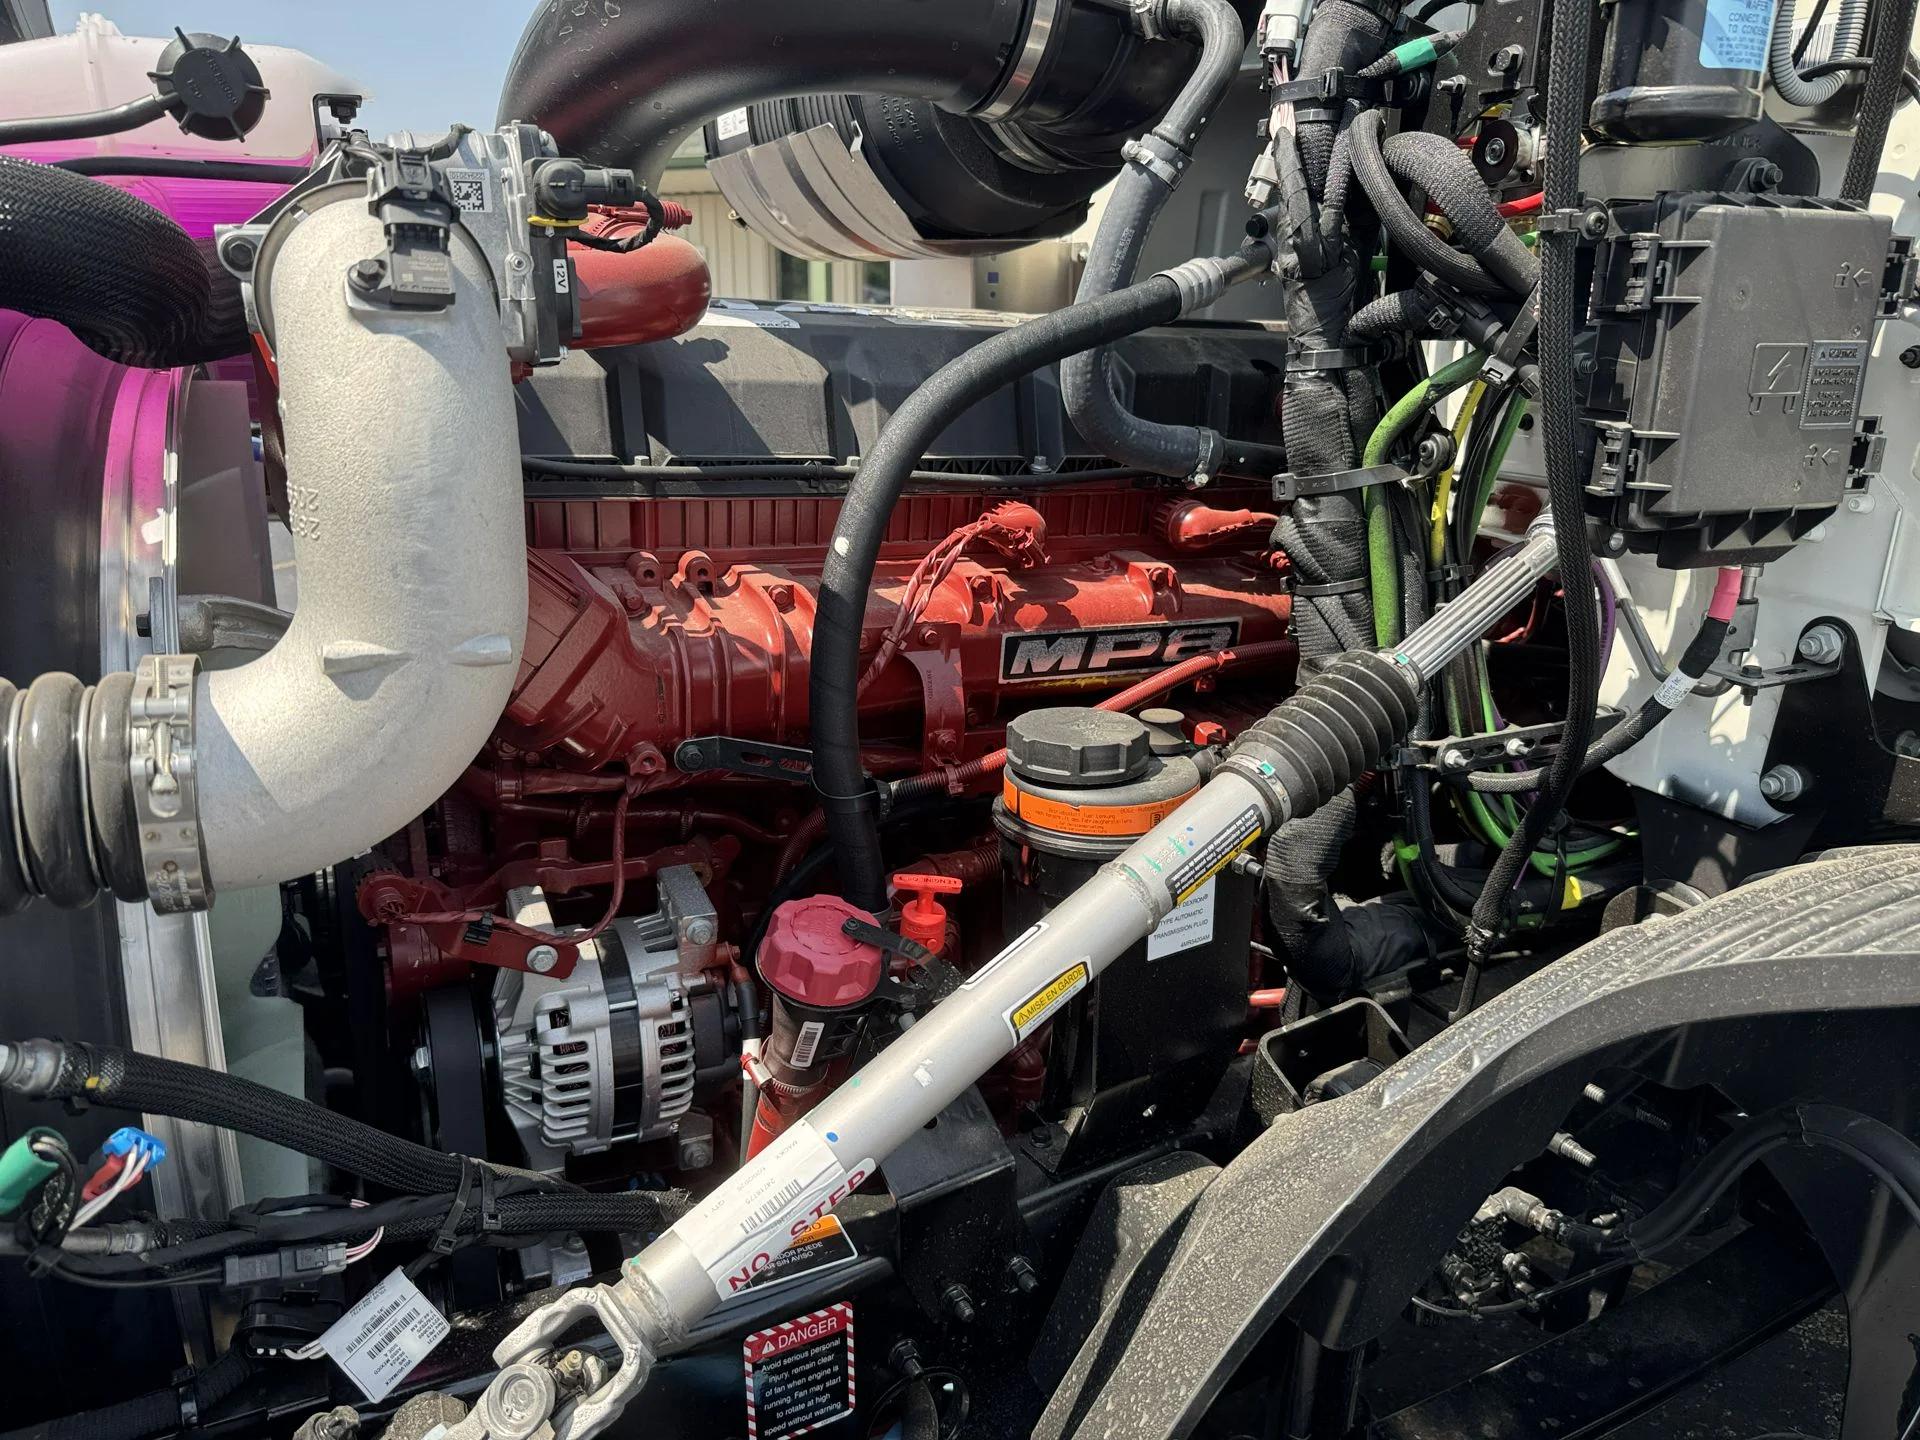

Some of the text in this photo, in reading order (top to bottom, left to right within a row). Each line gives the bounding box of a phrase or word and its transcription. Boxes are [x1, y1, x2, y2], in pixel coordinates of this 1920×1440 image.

[1728, 23, 1737, 33] TO
[556, 263, 565, 287] 12V
[1009, 627, 1232, 674] MP8
[1153, 918, 1208, 940] TRANSMISSION FLUID
[1159, 908, 1203, 925] TYPE AUTOMATIC
[1024, 995, 1047, 1016] MISE
[1044, 986, 1059, 1001] EN
[1055, 965, 1084, 991] GARDE
[796, 1241, 823, 1253] PUEDE
[728, 1252, 770, 1291] NO
[775, 1257, 790, 1267] SIN
[776, 1316, 838, 1348] DANGER
[760, 1337, 841, 1372] Avoid serious personal
[790, 1360, 816, 1374] remain
[816, 1352, 835, 1364] clear
[764, 1364, 839, 1397] of fan when engine is
[793, 1388, 807, 1399] Fan
[808, 1382, 824, 1393] may
[824, 1375, 841, 1387] start
[775, 1392, 831, 1418] to rotate at high
[763, 1421, 787, 1436] speed
[786, 1410, 813, 1426] without
